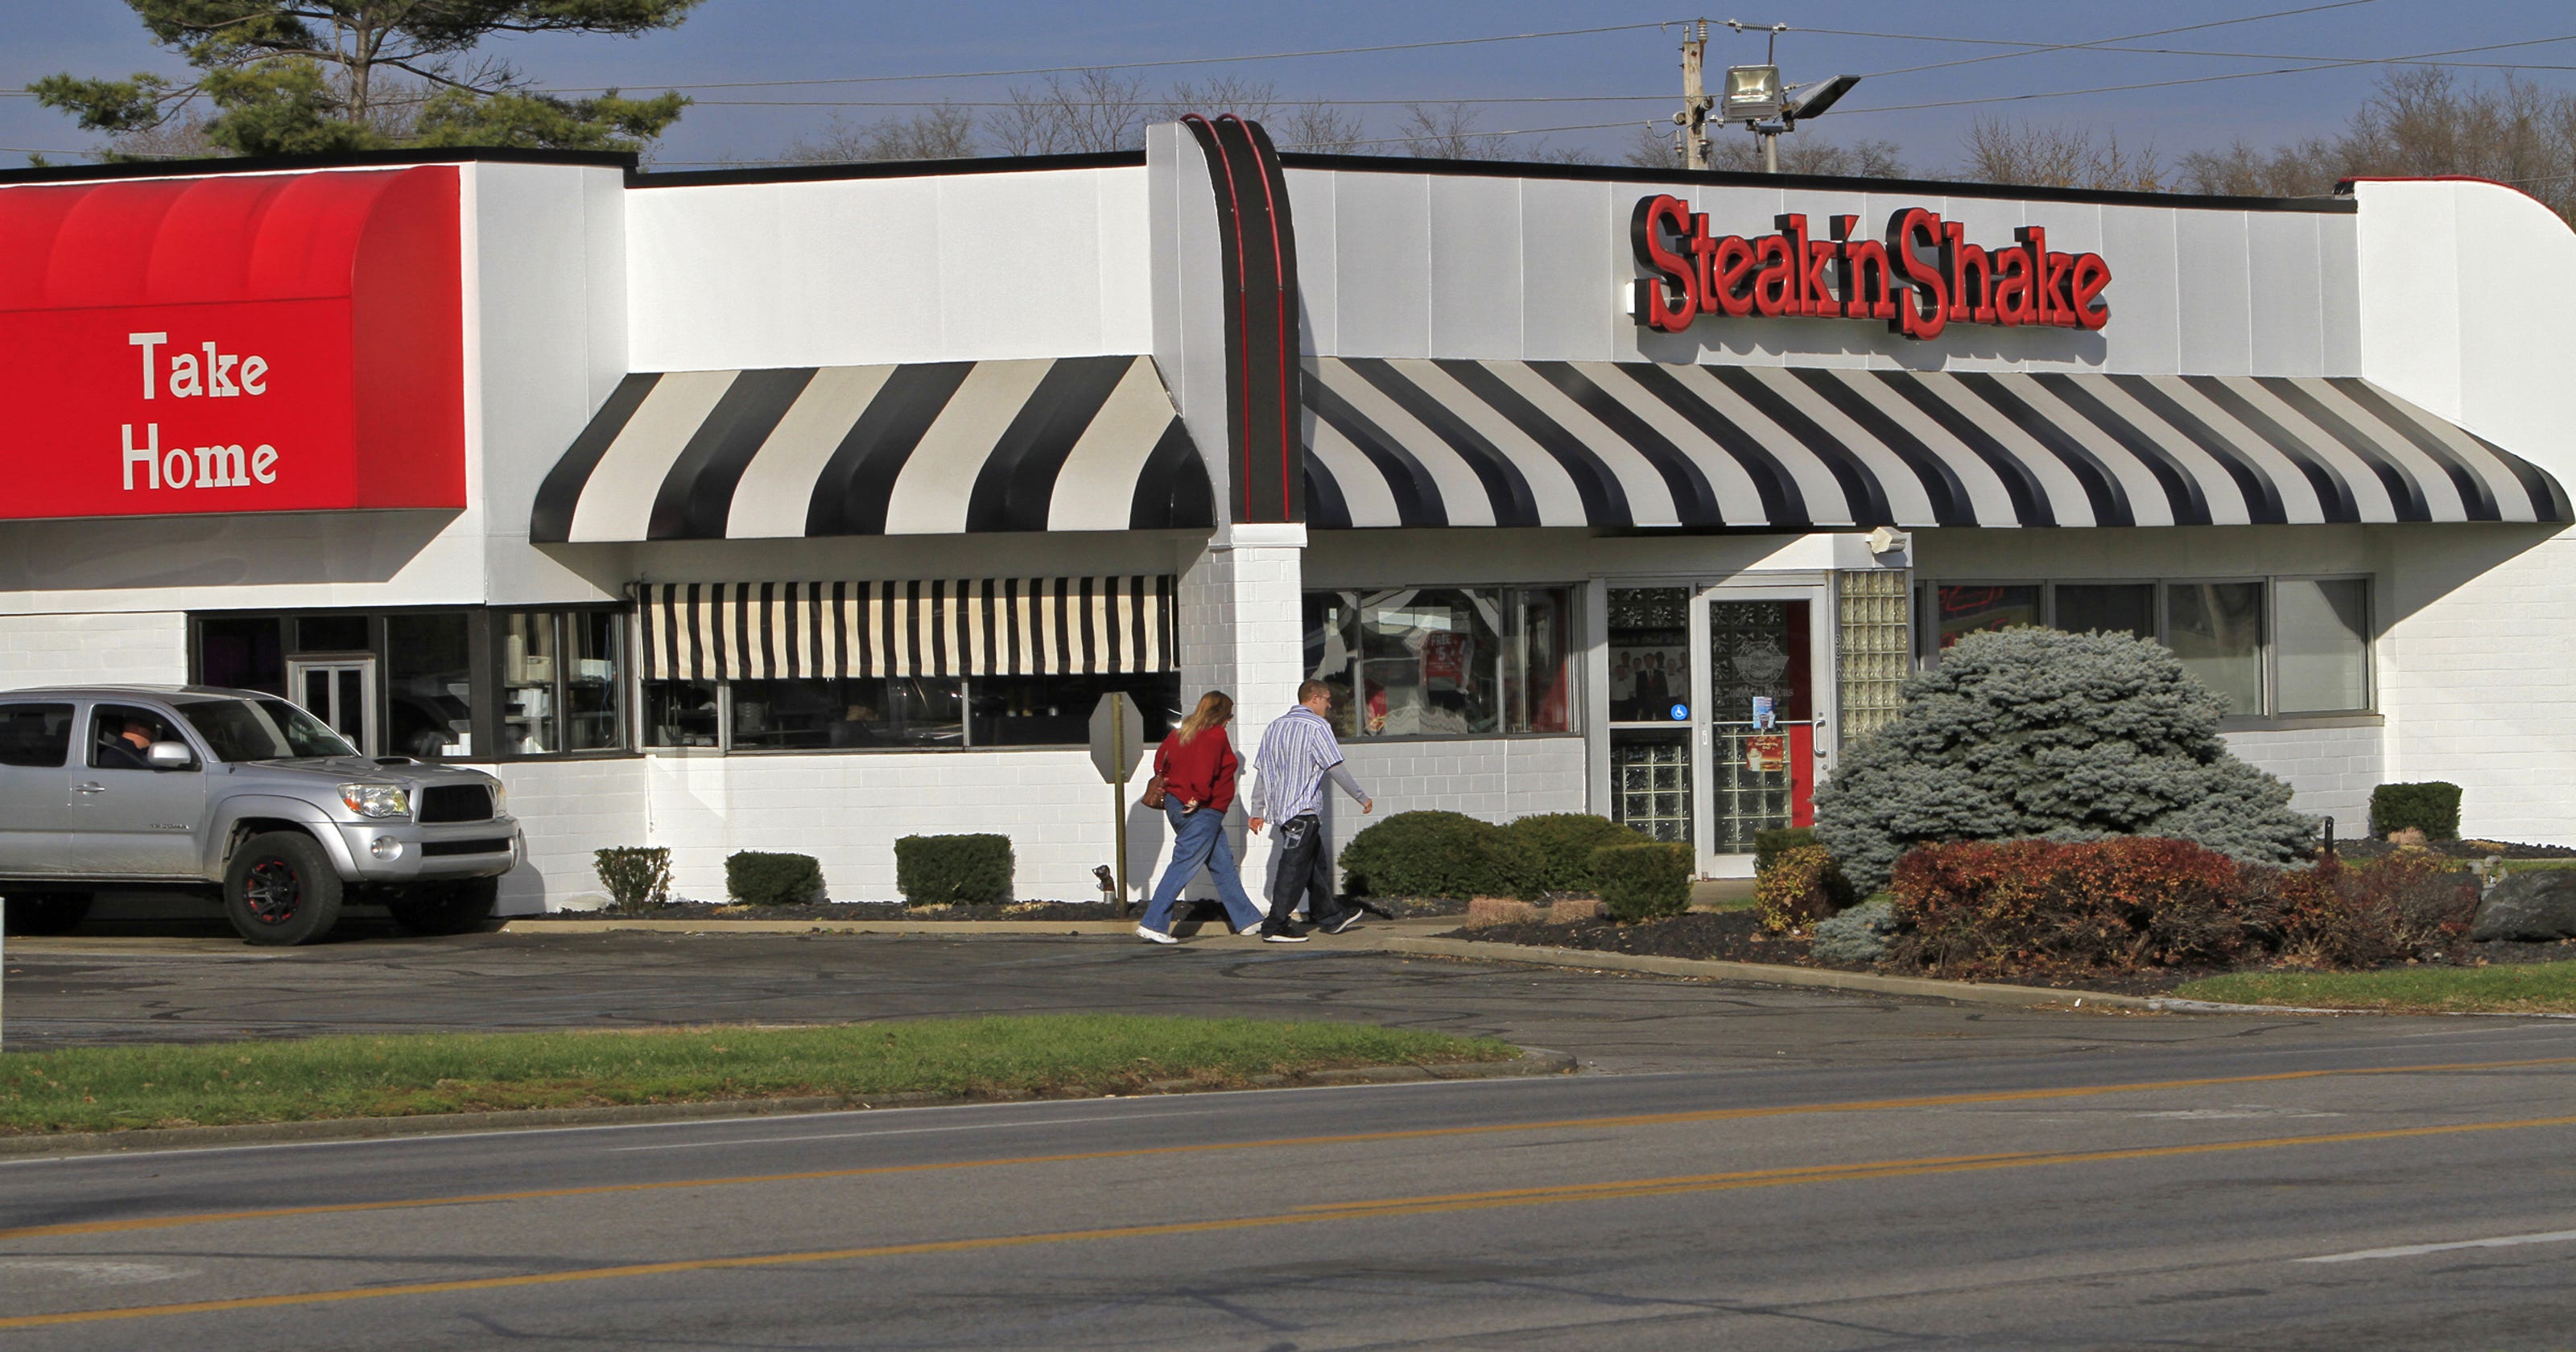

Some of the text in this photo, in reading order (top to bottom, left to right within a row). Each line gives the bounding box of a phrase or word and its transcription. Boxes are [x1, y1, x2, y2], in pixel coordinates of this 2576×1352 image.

[1886, 208, 2112, 340] Shake
[129, 332, 269, 399] Take
[122, 422, 279, 490] Home
